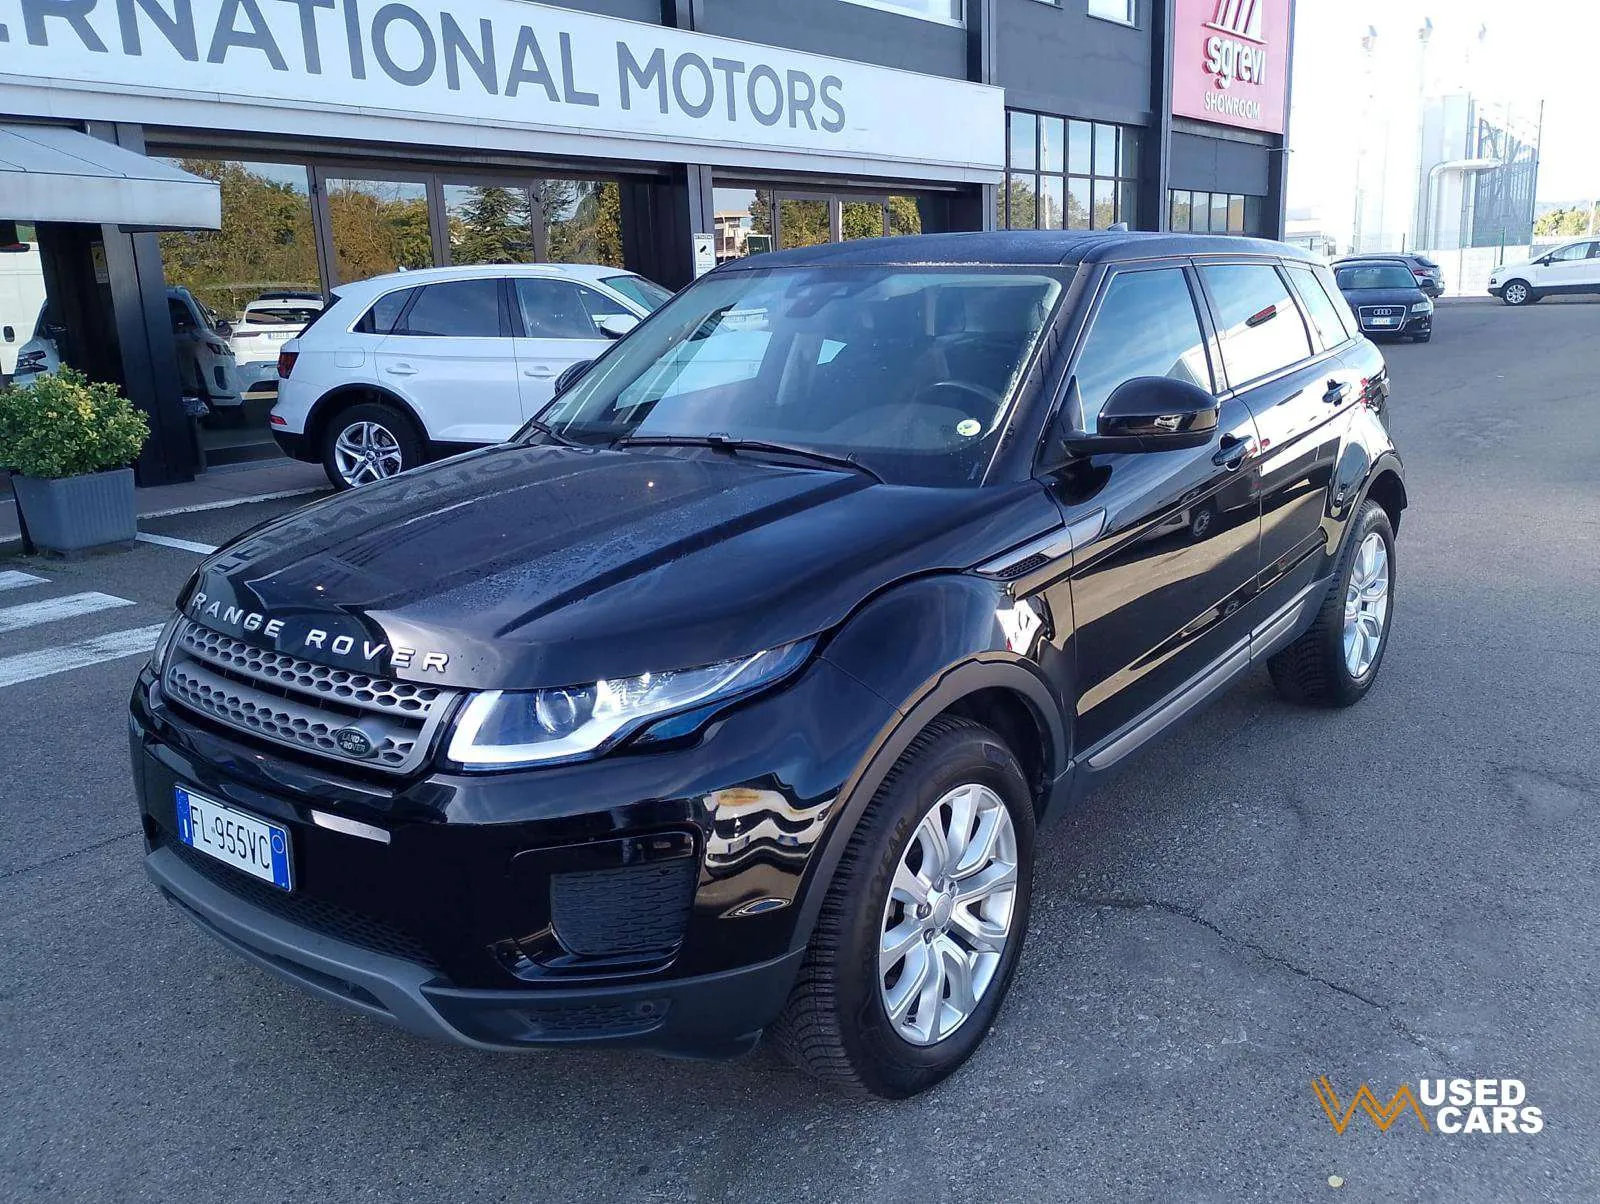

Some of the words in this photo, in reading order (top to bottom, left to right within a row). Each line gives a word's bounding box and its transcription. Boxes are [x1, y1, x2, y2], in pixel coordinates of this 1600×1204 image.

[0, 0, 600, 107] RNATIONAL
[616, 41, 846, 133] MOTORS
[1204, 91, 1261, 119] SHOWROOM
[192, 592, 285, 638] RANGE
[304, 629, 450, 673] ROVER
